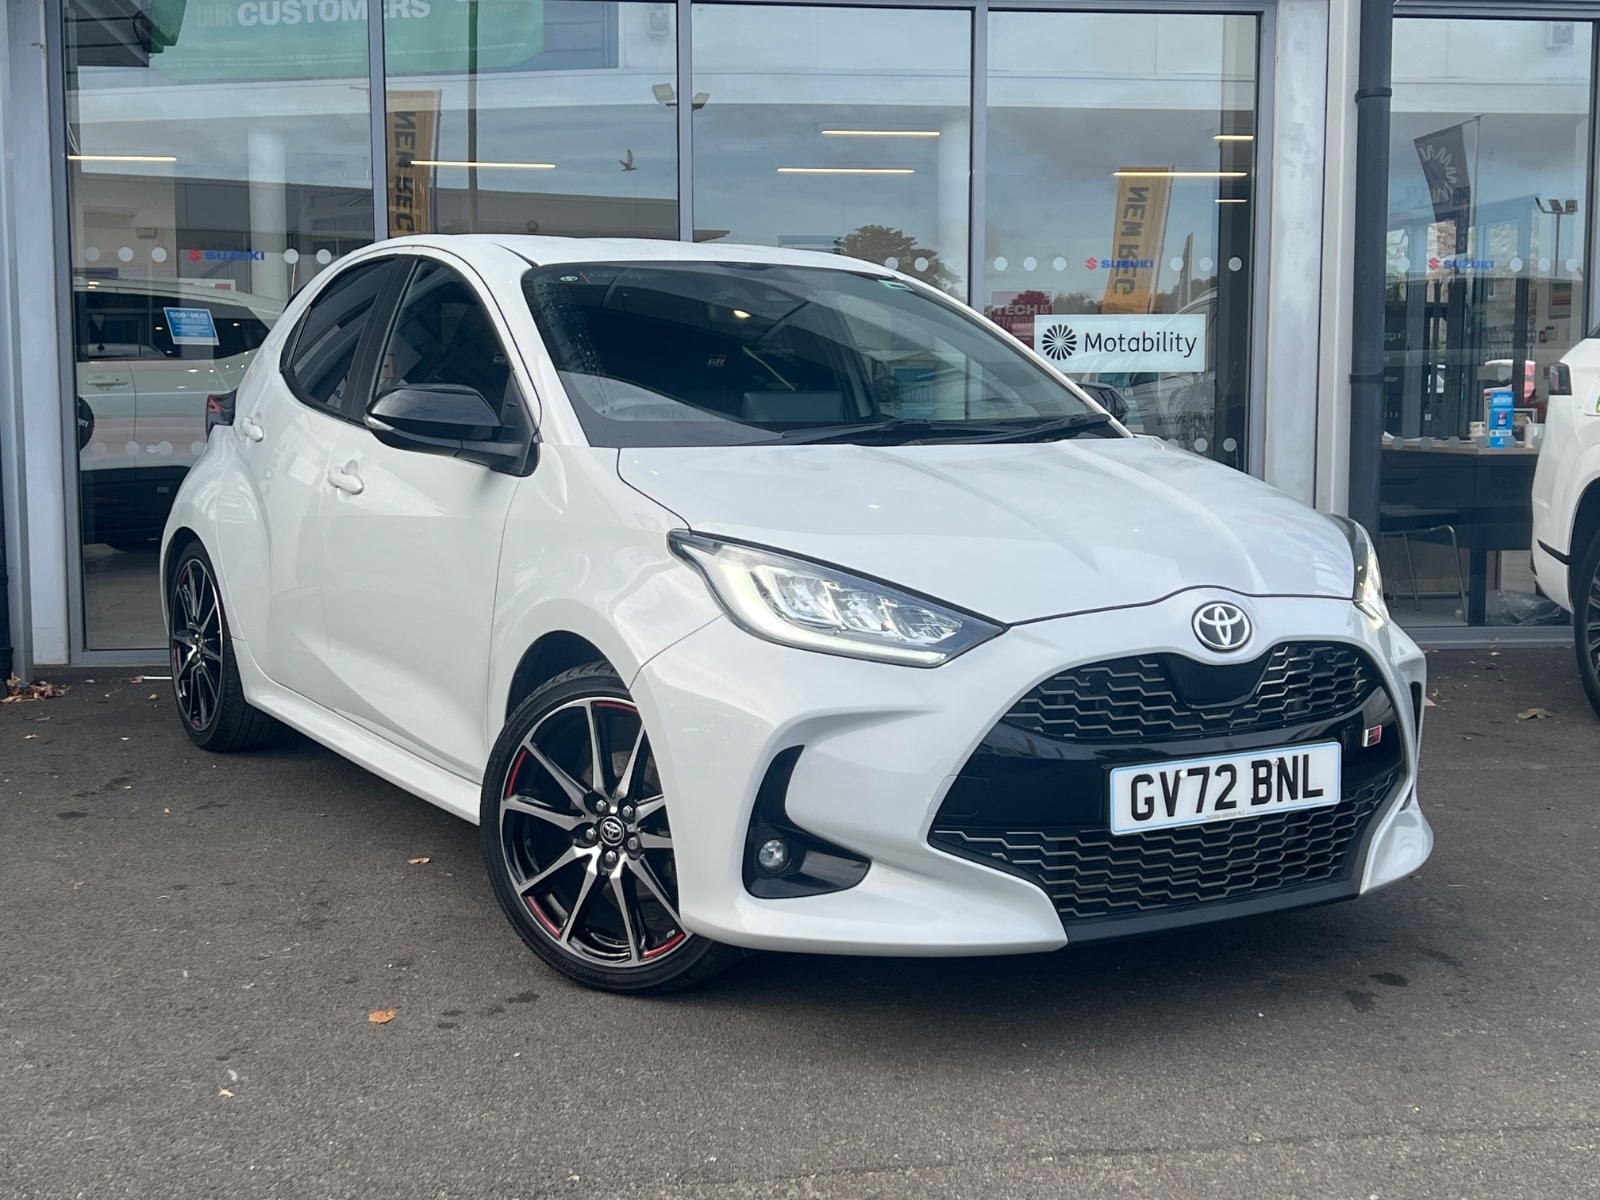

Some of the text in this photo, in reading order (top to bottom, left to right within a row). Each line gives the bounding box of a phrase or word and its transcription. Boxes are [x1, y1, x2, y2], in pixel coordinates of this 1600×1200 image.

[196, 4, 233, 27] OUR
[205, 251, 265, 261] SUZUKI
[1100, 259, 1154, 269] SUZUKI
[1443, 260, 1495, 269] SUZUKI
[994, 304, 1037, 316] TECH
[1084, 331, 1198, 358] Motability
[1131, 754, 1324, 821] GV72 BNL
